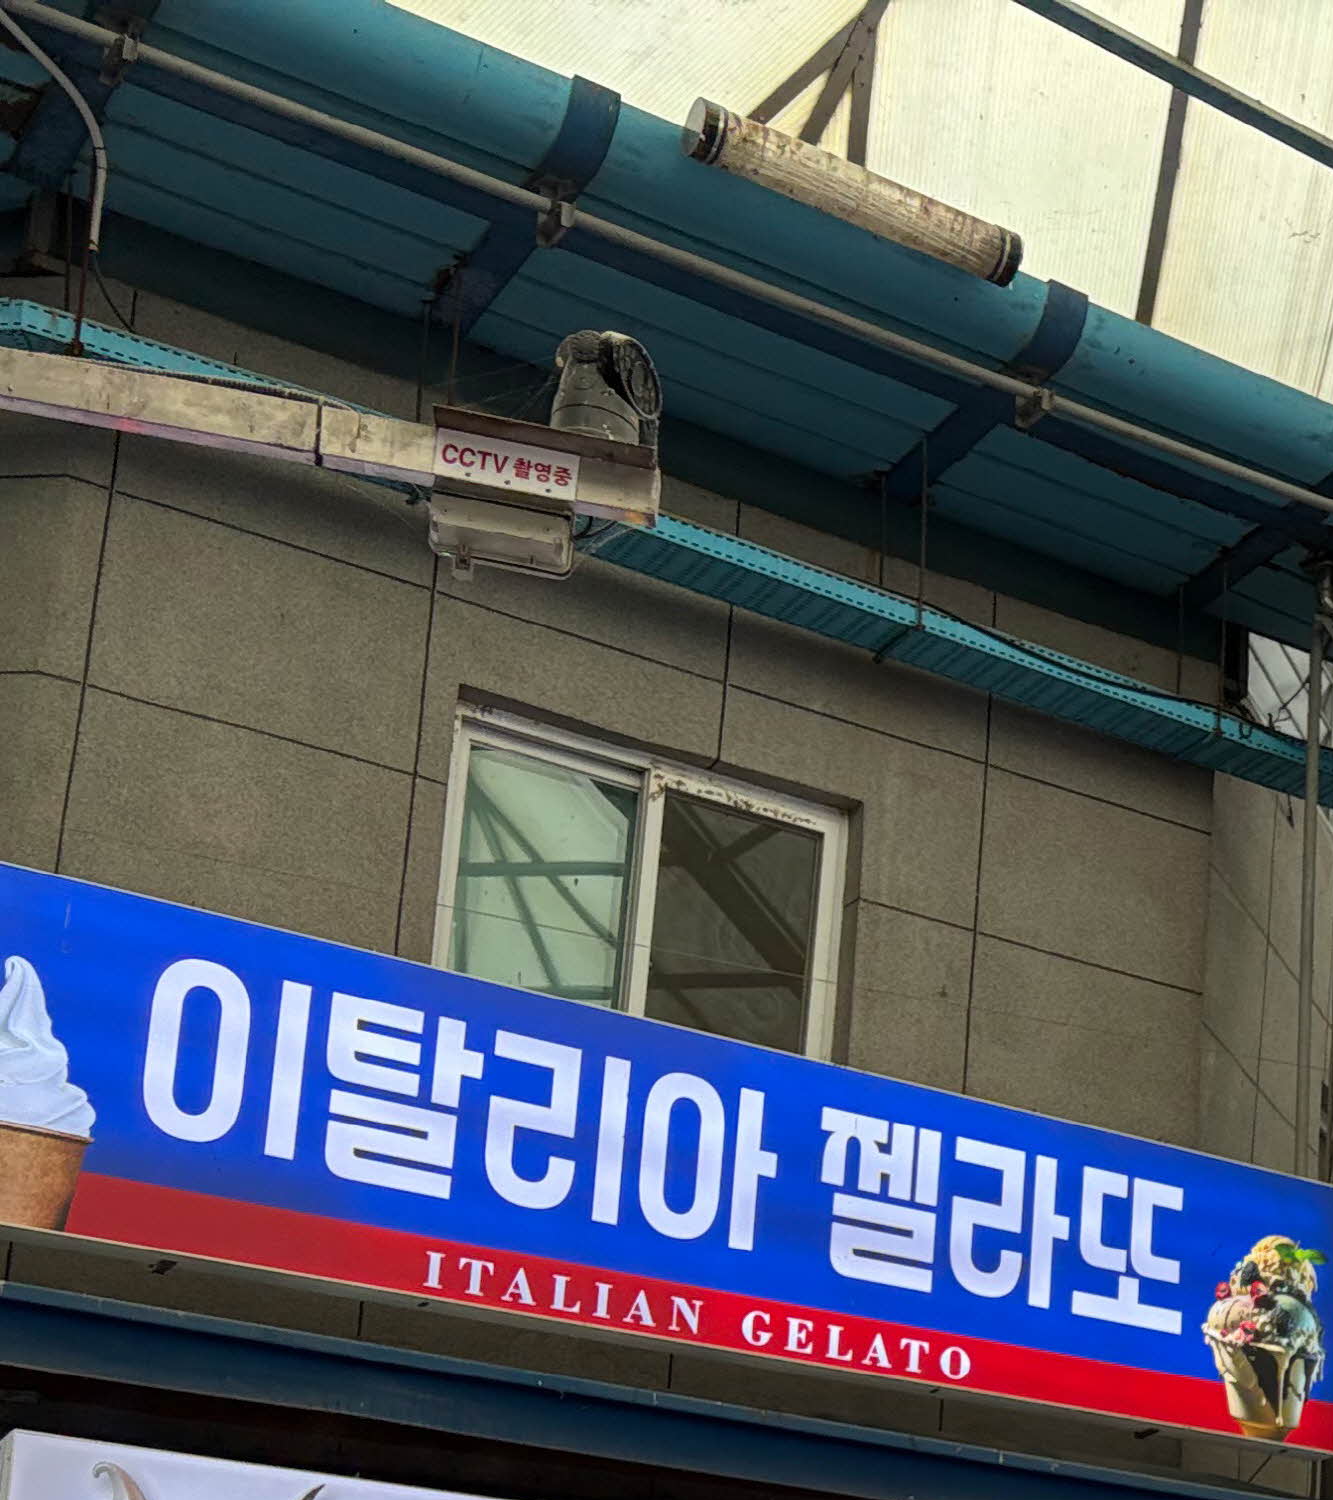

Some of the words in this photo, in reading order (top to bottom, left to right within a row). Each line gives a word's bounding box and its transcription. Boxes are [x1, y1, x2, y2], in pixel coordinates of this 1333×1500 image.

[441, 442, 508, 475] CCTV
[513, 457, 573, 486] 촬영중
[143, 958, 779, 1252] 이탈리아
[423, 1251, 704, 1335] ITALIAN
[740, 1310, 972, 1380] GELATO
